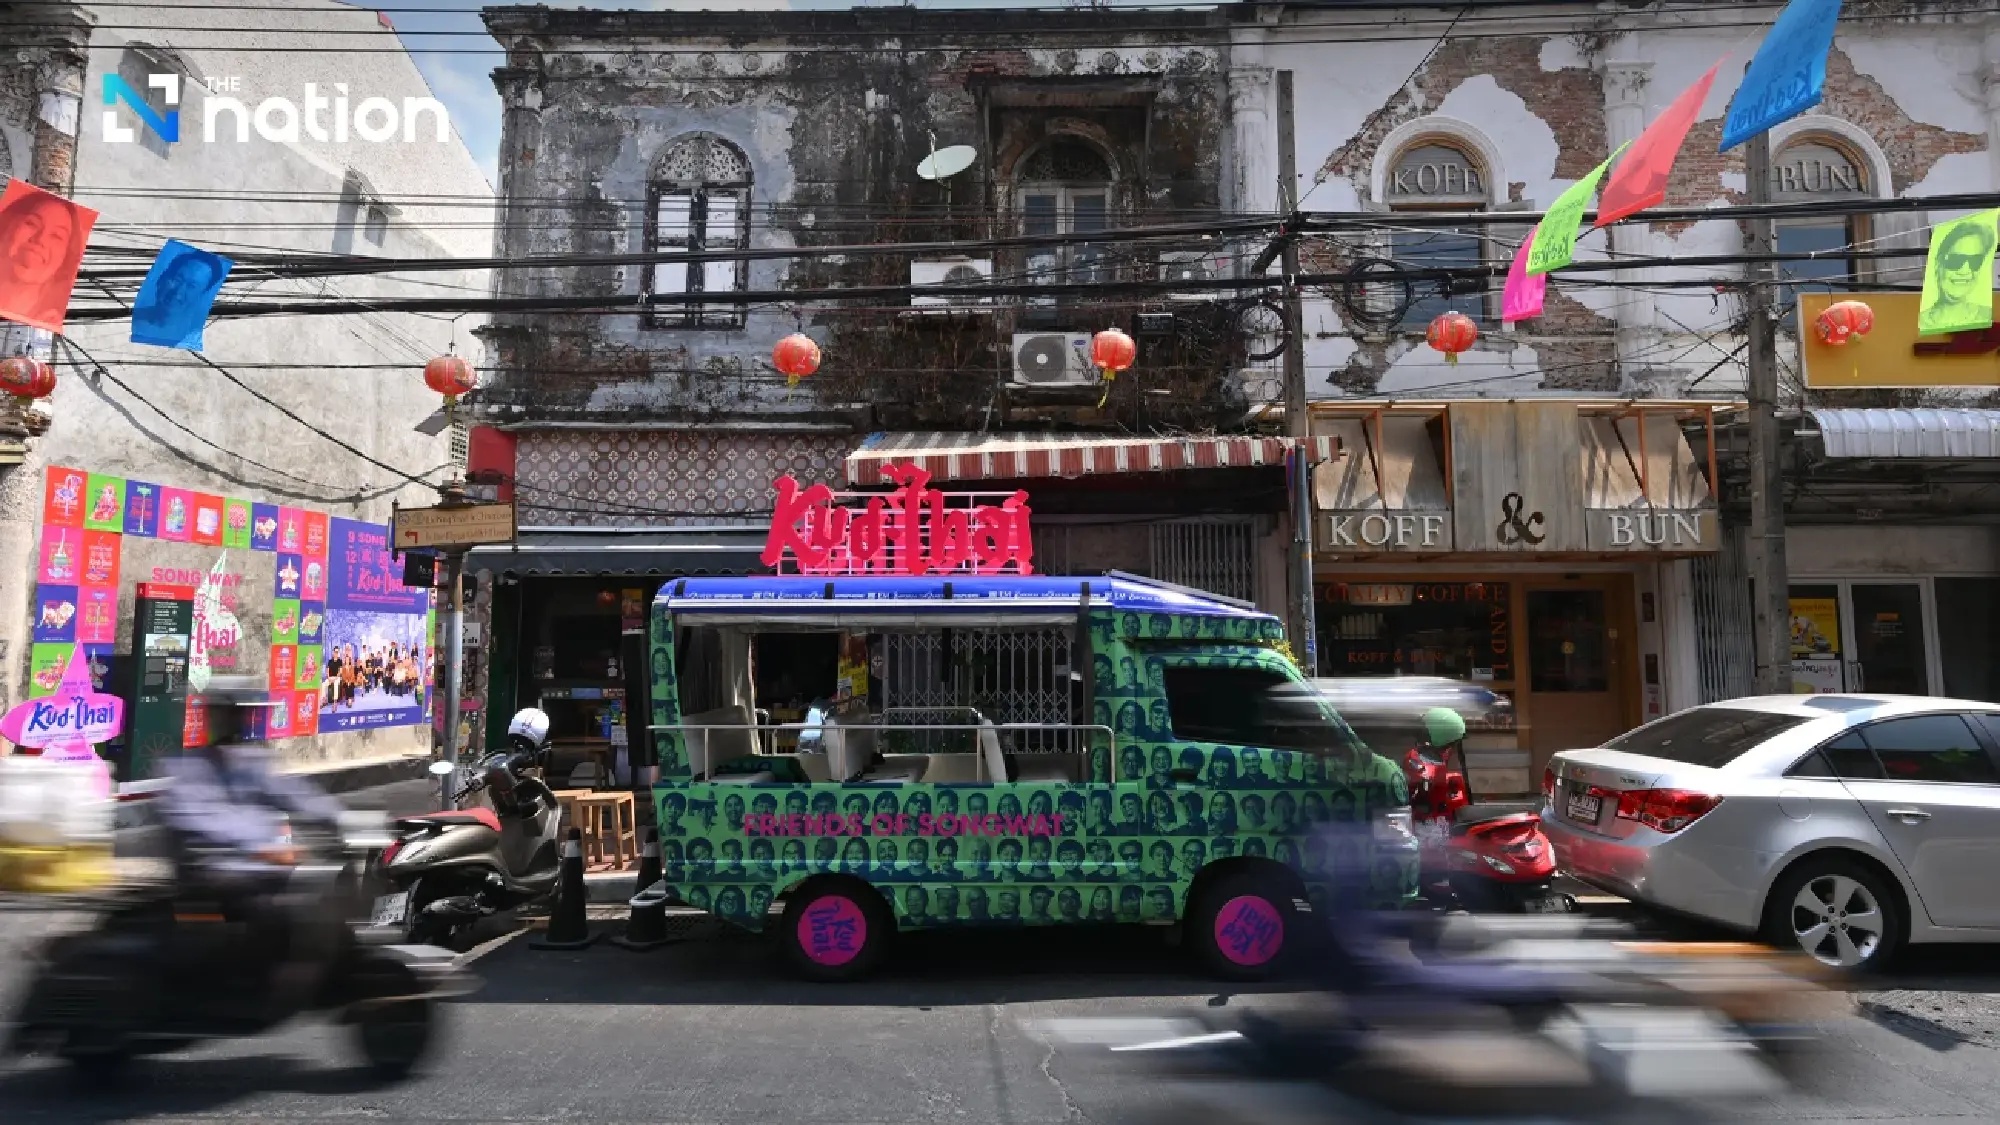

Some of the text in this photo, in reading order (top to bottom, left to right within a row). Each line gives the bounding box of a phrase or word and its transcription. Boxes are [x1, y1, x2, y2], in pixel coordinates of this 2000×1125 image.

[1393, 163, 1479, 194] KOFF
[1777, 160, 1854, 193] BUN
[1329, 492, 1702, 547] KOFF & BUN
[152, 567, 243, 586] SONG WAT
[1314, 583, 1506, 603] ECIALTY COFFEE
[744, 813, 1065, 837] FRIENDS OF SONGWAT
